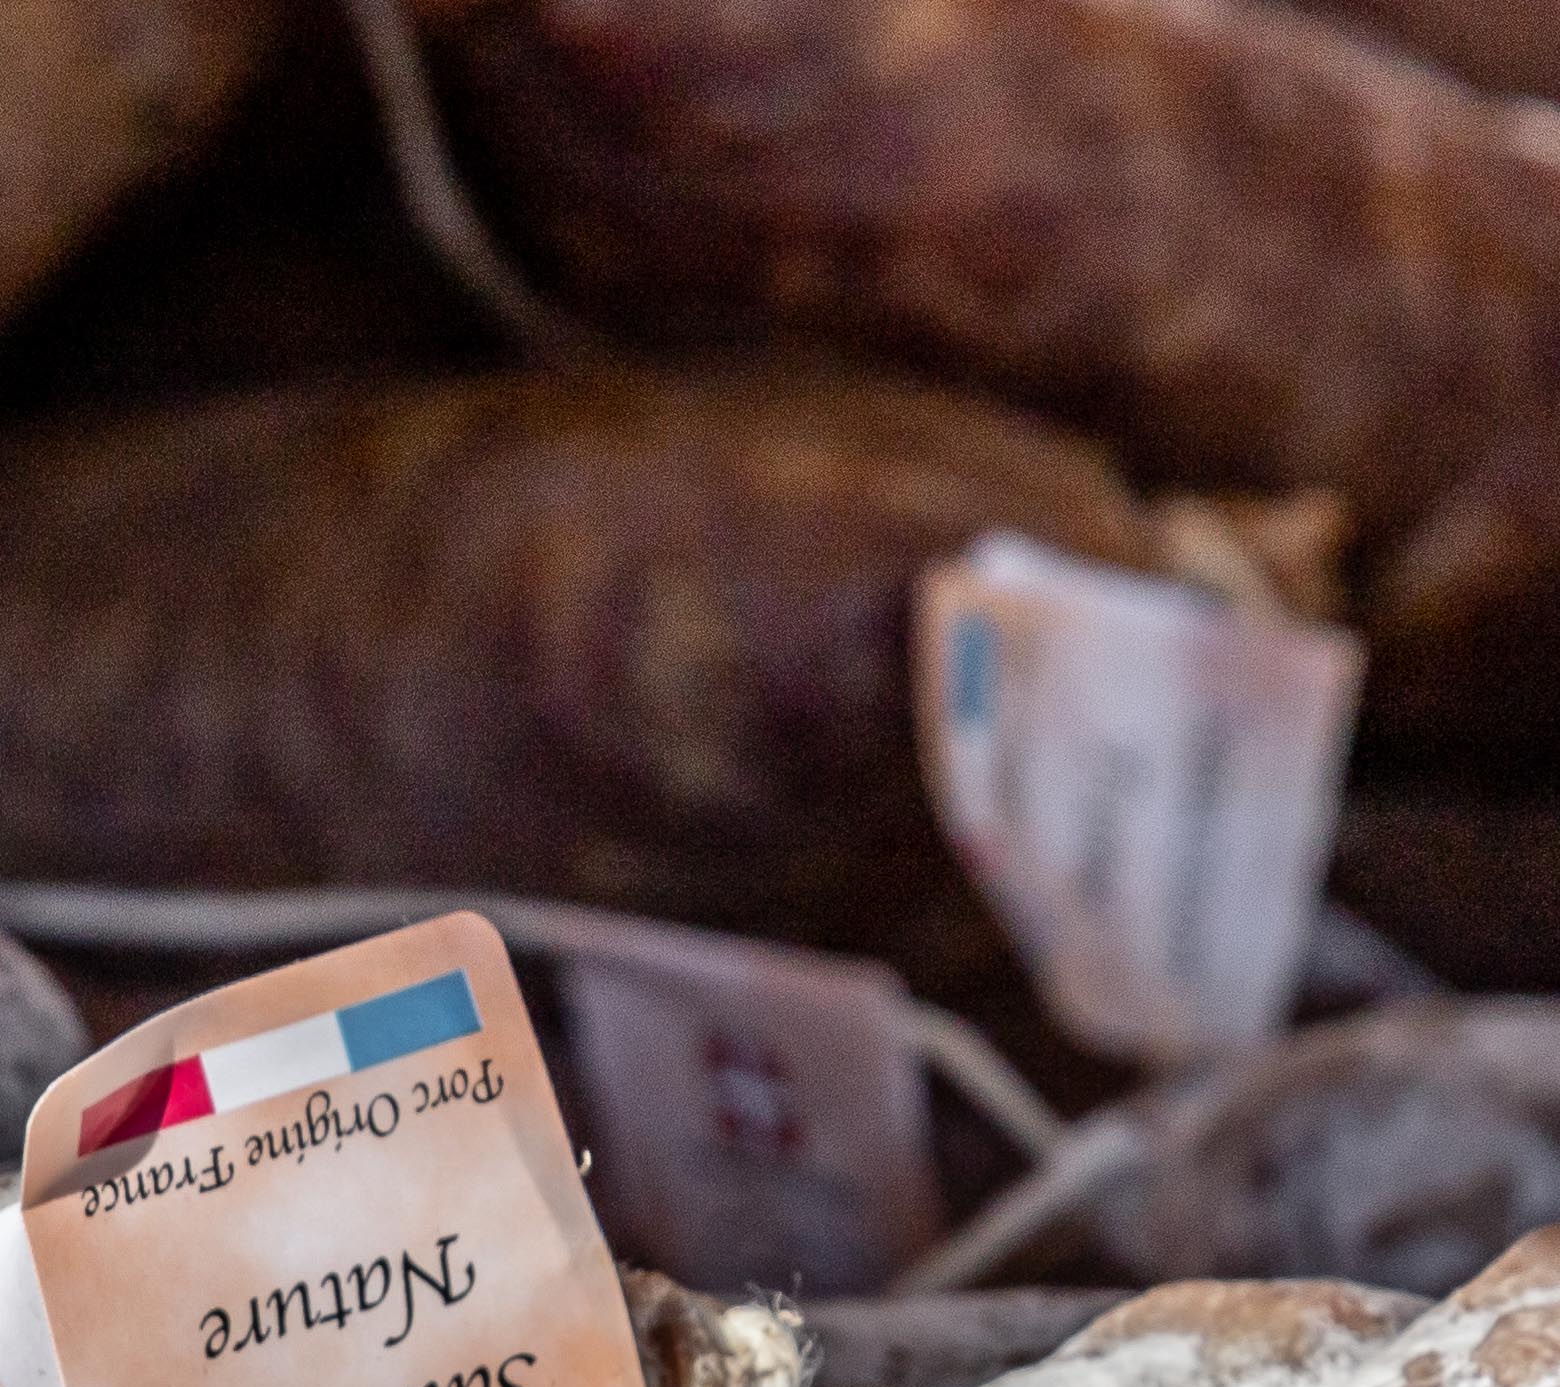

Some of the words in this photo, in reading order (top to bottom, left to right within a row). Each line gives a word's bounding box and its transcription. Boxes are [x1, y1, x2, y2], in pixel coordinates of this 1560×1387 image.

[412, 1058, 504, 1113] Porc
[244, 1090, 399, 1167] Origine
[82, 1146, 234, 1219] France
[199, 1234, 476, 1358] Nature
